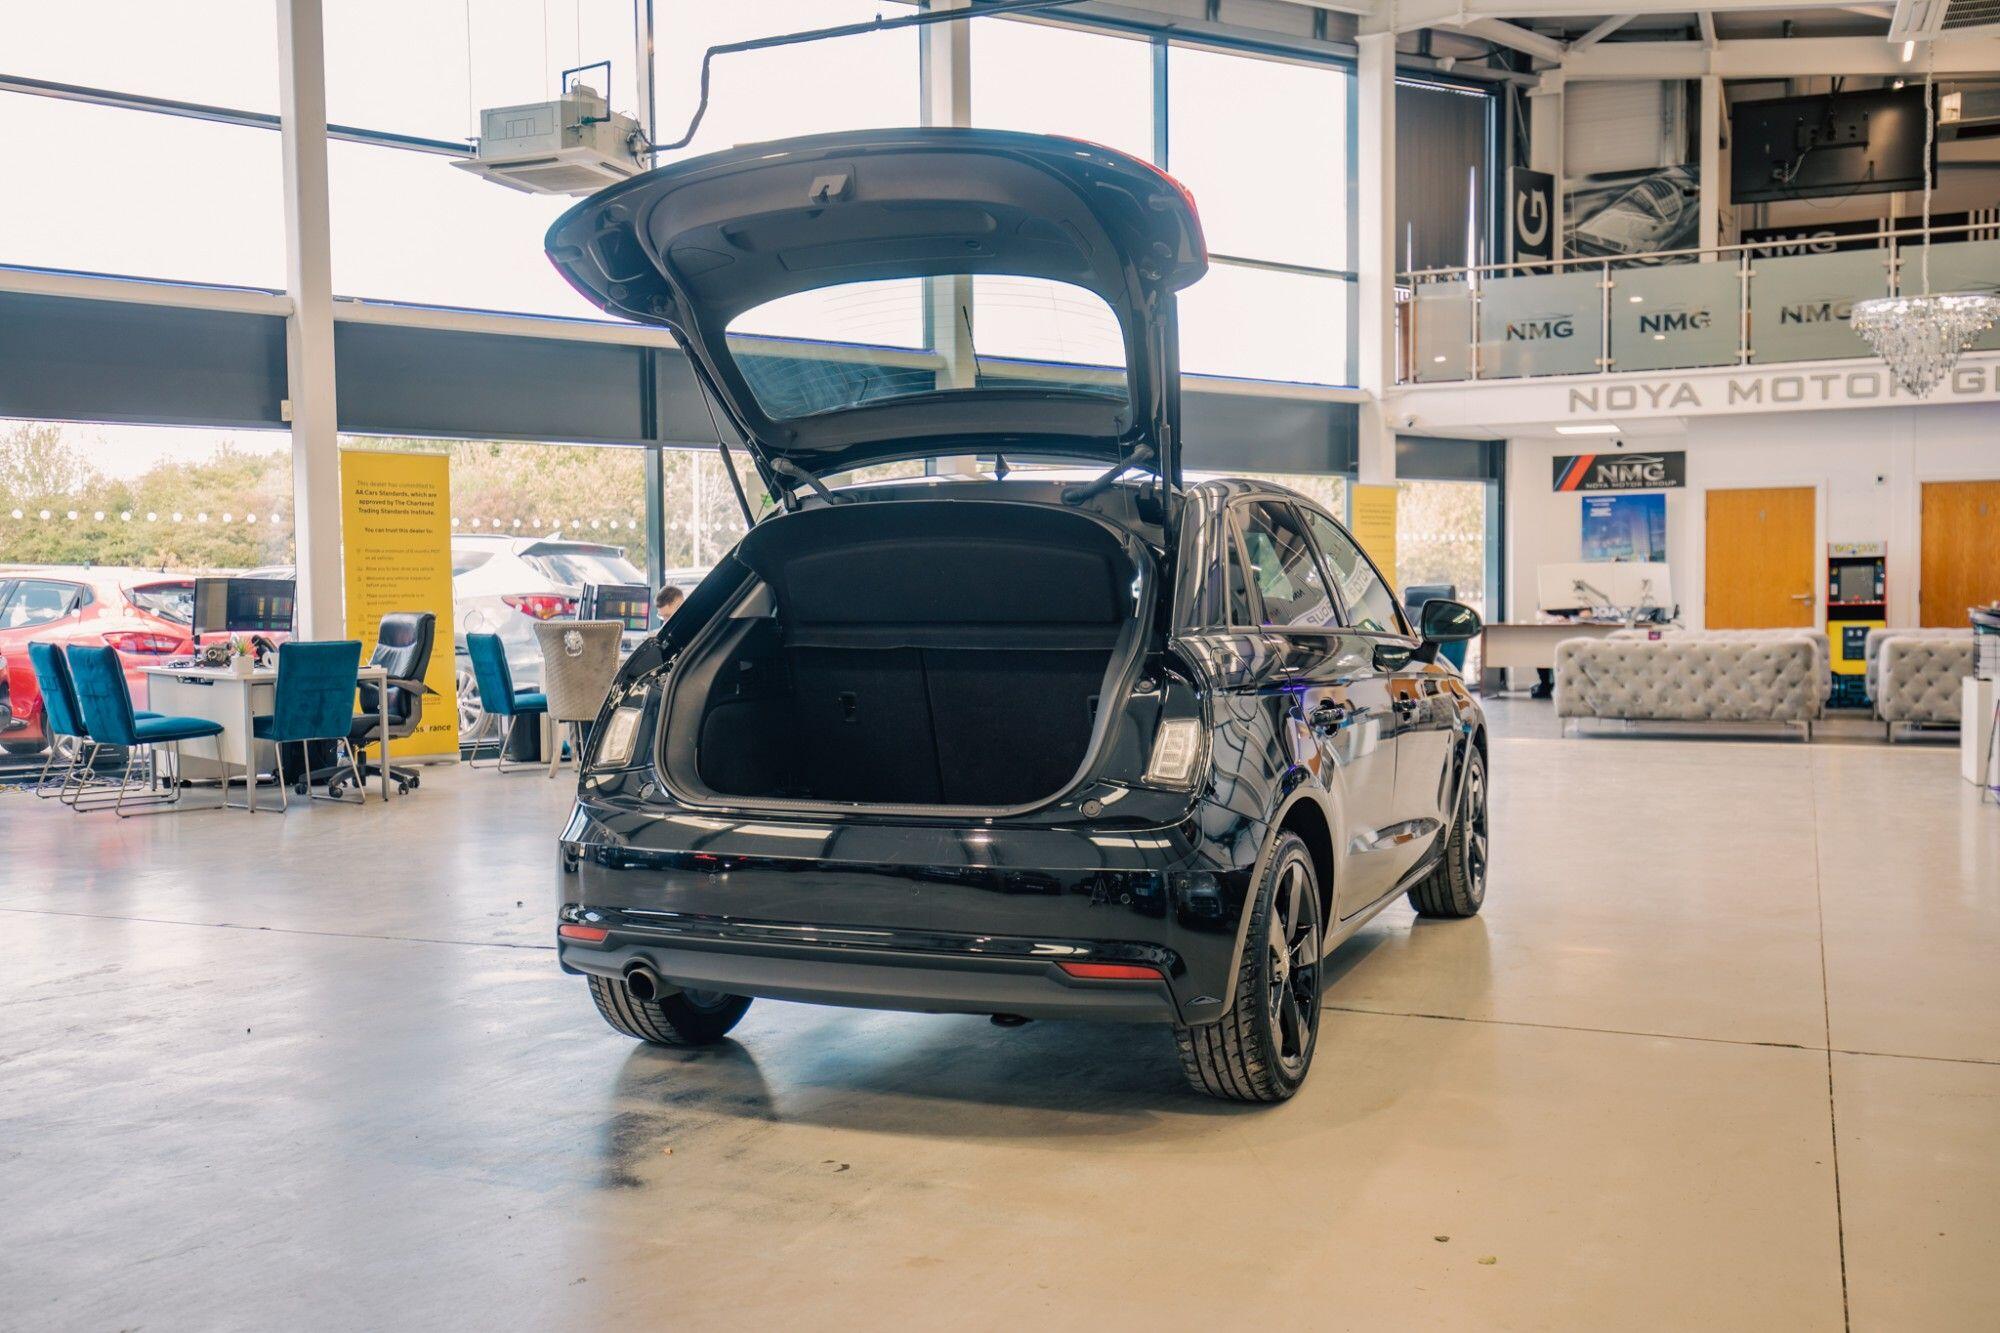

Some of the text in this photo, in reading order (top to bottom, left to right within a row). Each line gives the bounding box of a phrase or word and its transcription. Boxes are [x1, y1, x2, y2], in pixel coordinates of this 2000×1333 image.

[1746, 231, 1838, 257] NMG
[1507, 321, 1574, 341] NMG
[1640, 311, 1711, 333] NMG
[1569, 382, 1701, 412] NOYA
[1952, 365, 2000, 394] G
[1597, 463, 1665, 483] NMG
[1645, 479, 1677, 487] GROUP
